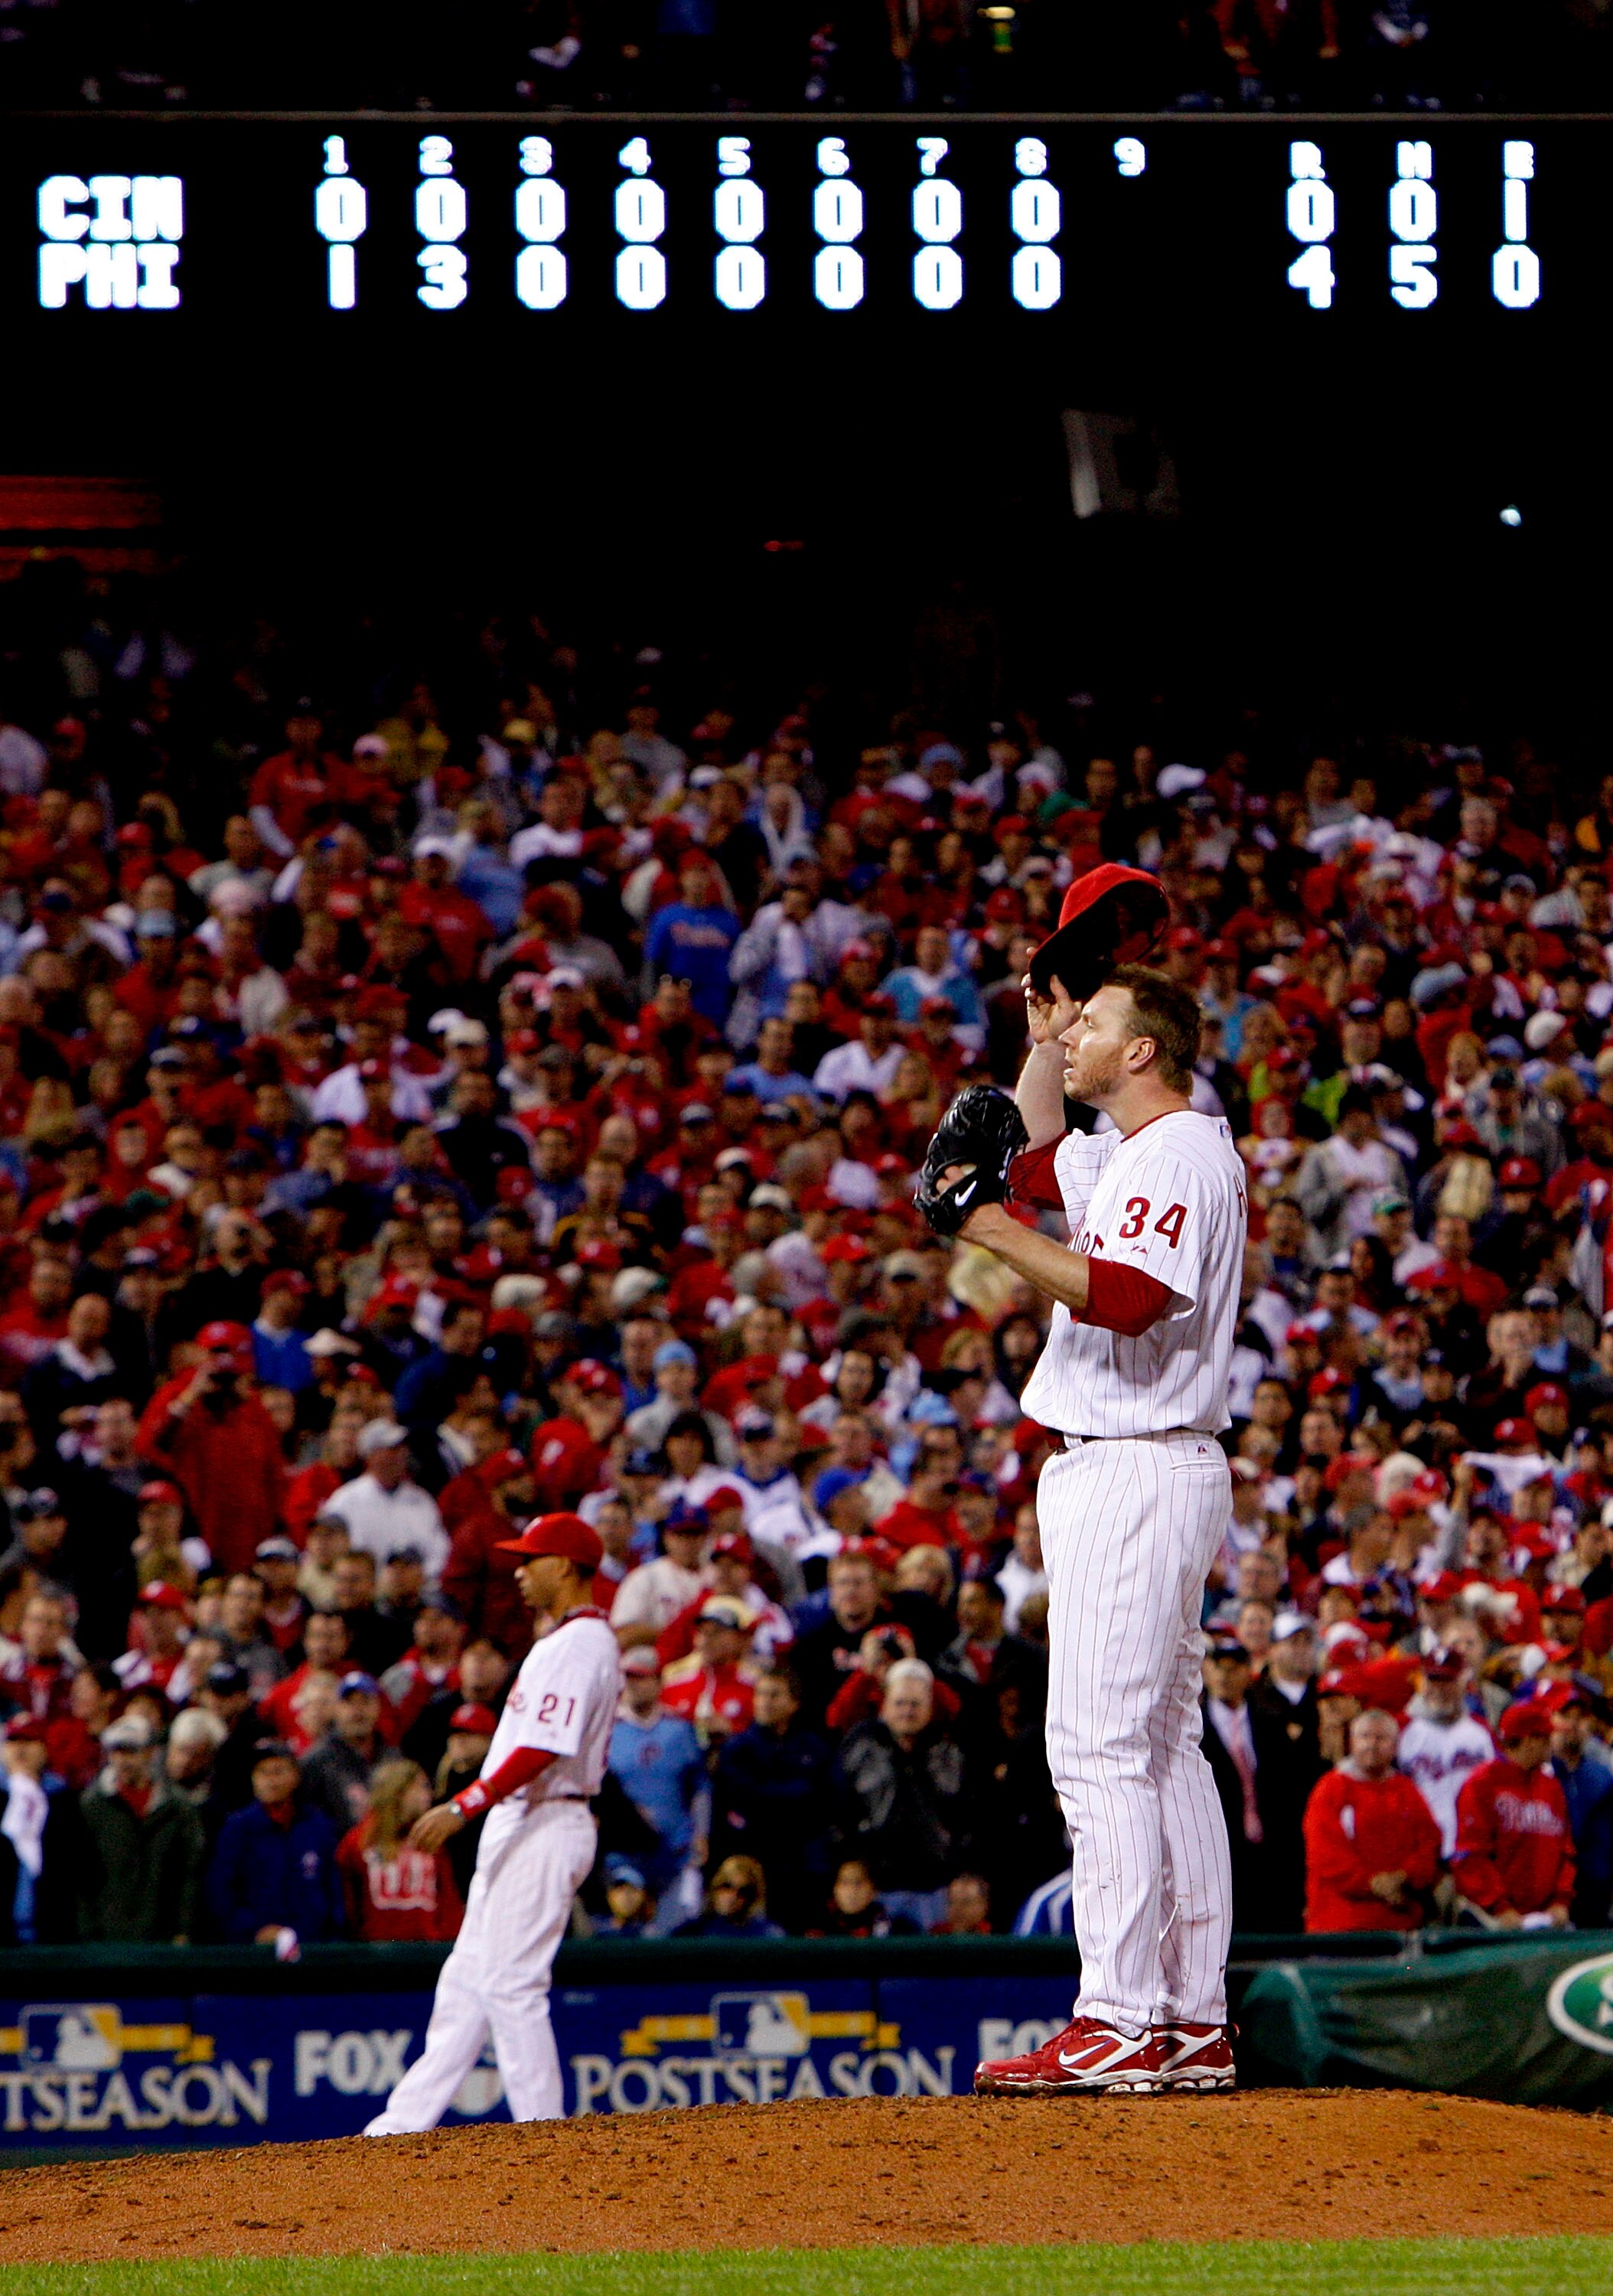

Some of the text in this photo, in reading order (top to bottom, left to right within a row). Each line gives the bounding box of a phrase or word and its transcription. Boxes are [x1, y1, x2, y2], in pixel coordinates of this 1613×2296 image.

[324, 135, 1533, 178] 1 2 3 4 5 6 7 8 9 R H E
[38, 175, 1527, 243] CIN 0 0 0 0 0 0 0 0 0 0 1
[39, 243, 1540, 309] PHI 1 3 0 0 0 0 0 0 4 5 0
[1119, 1196, 1188, 1250] 34
[538, 1693, 576, 1727] 21
[294, 2030, 413, 2096] FOX
[979, 2017, 1071, 2060] FO
[0, 2058, 274, 2132] TSEASON
[571, 2046, 956, 2117] POSTSEASON
